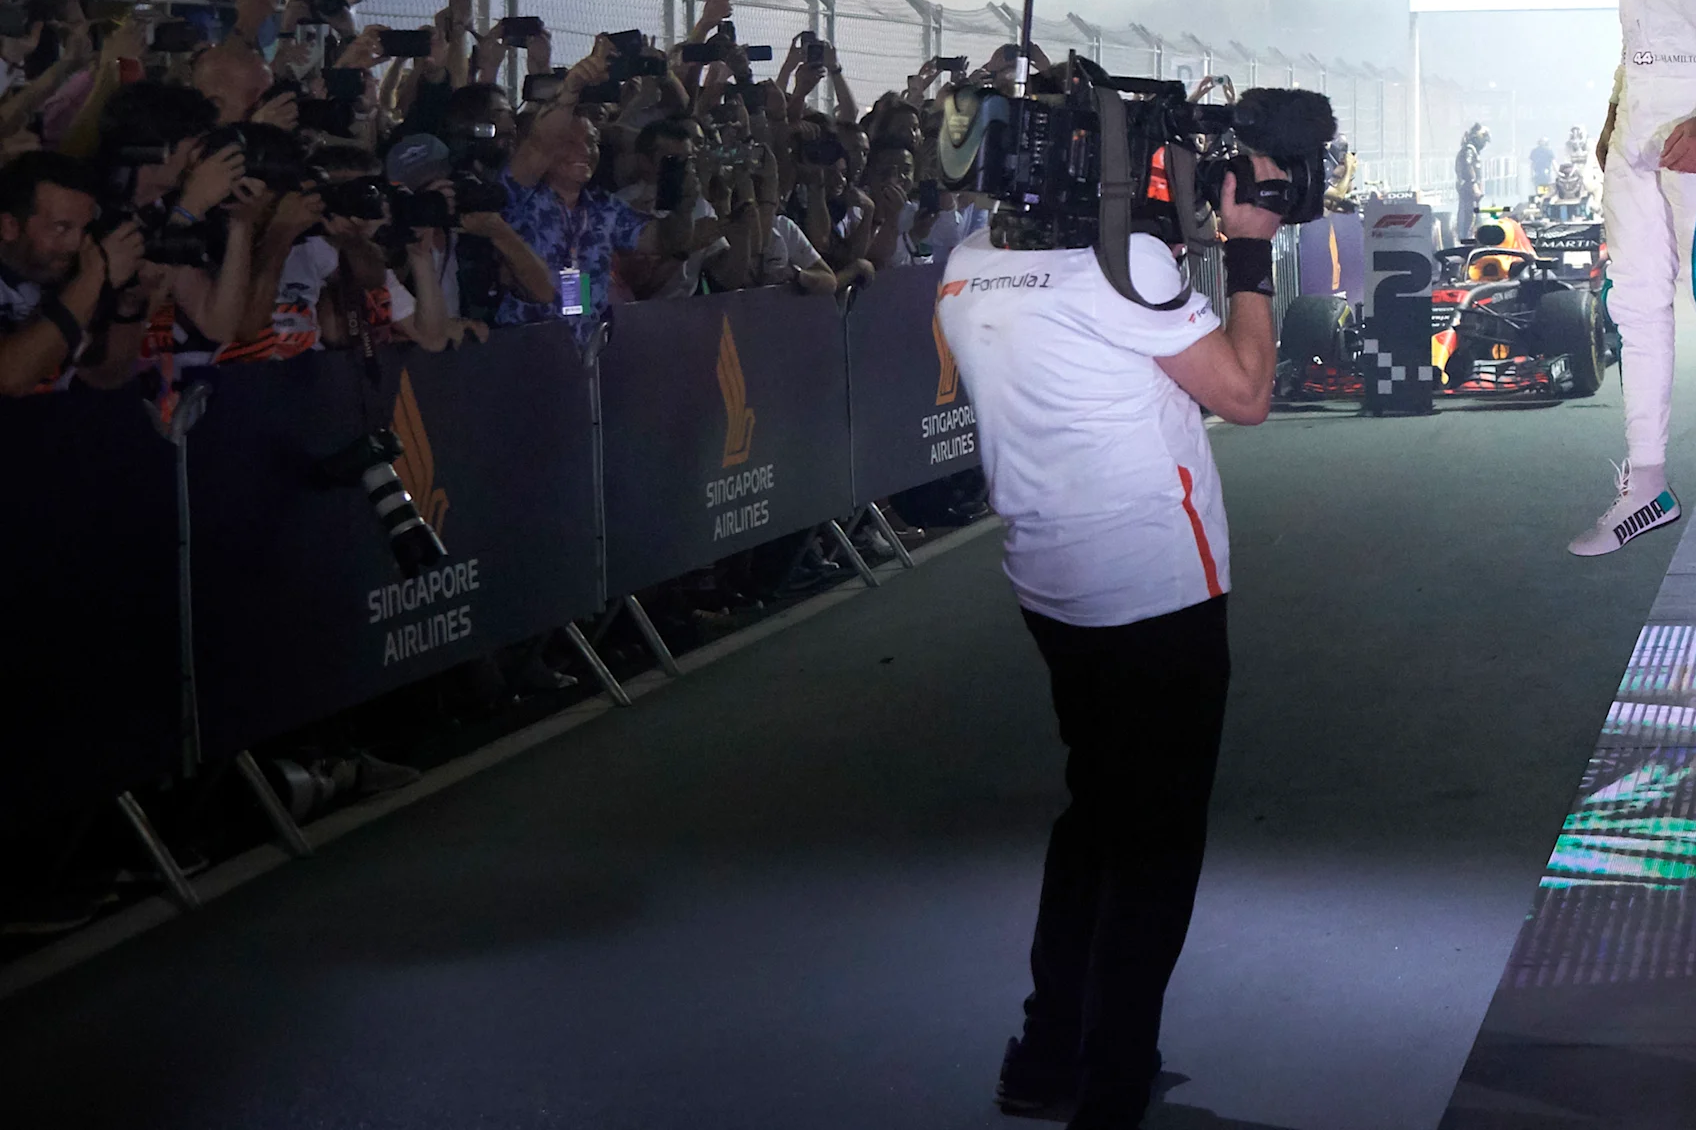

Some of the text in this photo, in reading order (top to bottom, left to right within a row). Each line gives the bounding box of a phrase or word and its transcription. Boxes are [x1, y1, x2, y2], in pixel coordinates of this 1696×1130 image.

[1633, 51, 1654, 65] 44
[1541, 239, 1600, 248] MARTIN
[930, 432, 975, 465] AIRLINES
[706, 463, 775, 508] SINGAPORE
[713, 499, 769, 541] AIRLINES
[1613, 498, 1666, 546] PUMA
[368, 558, 480, 624] SINGAPORE
[383, 604, 472, 667] AIRLINES
